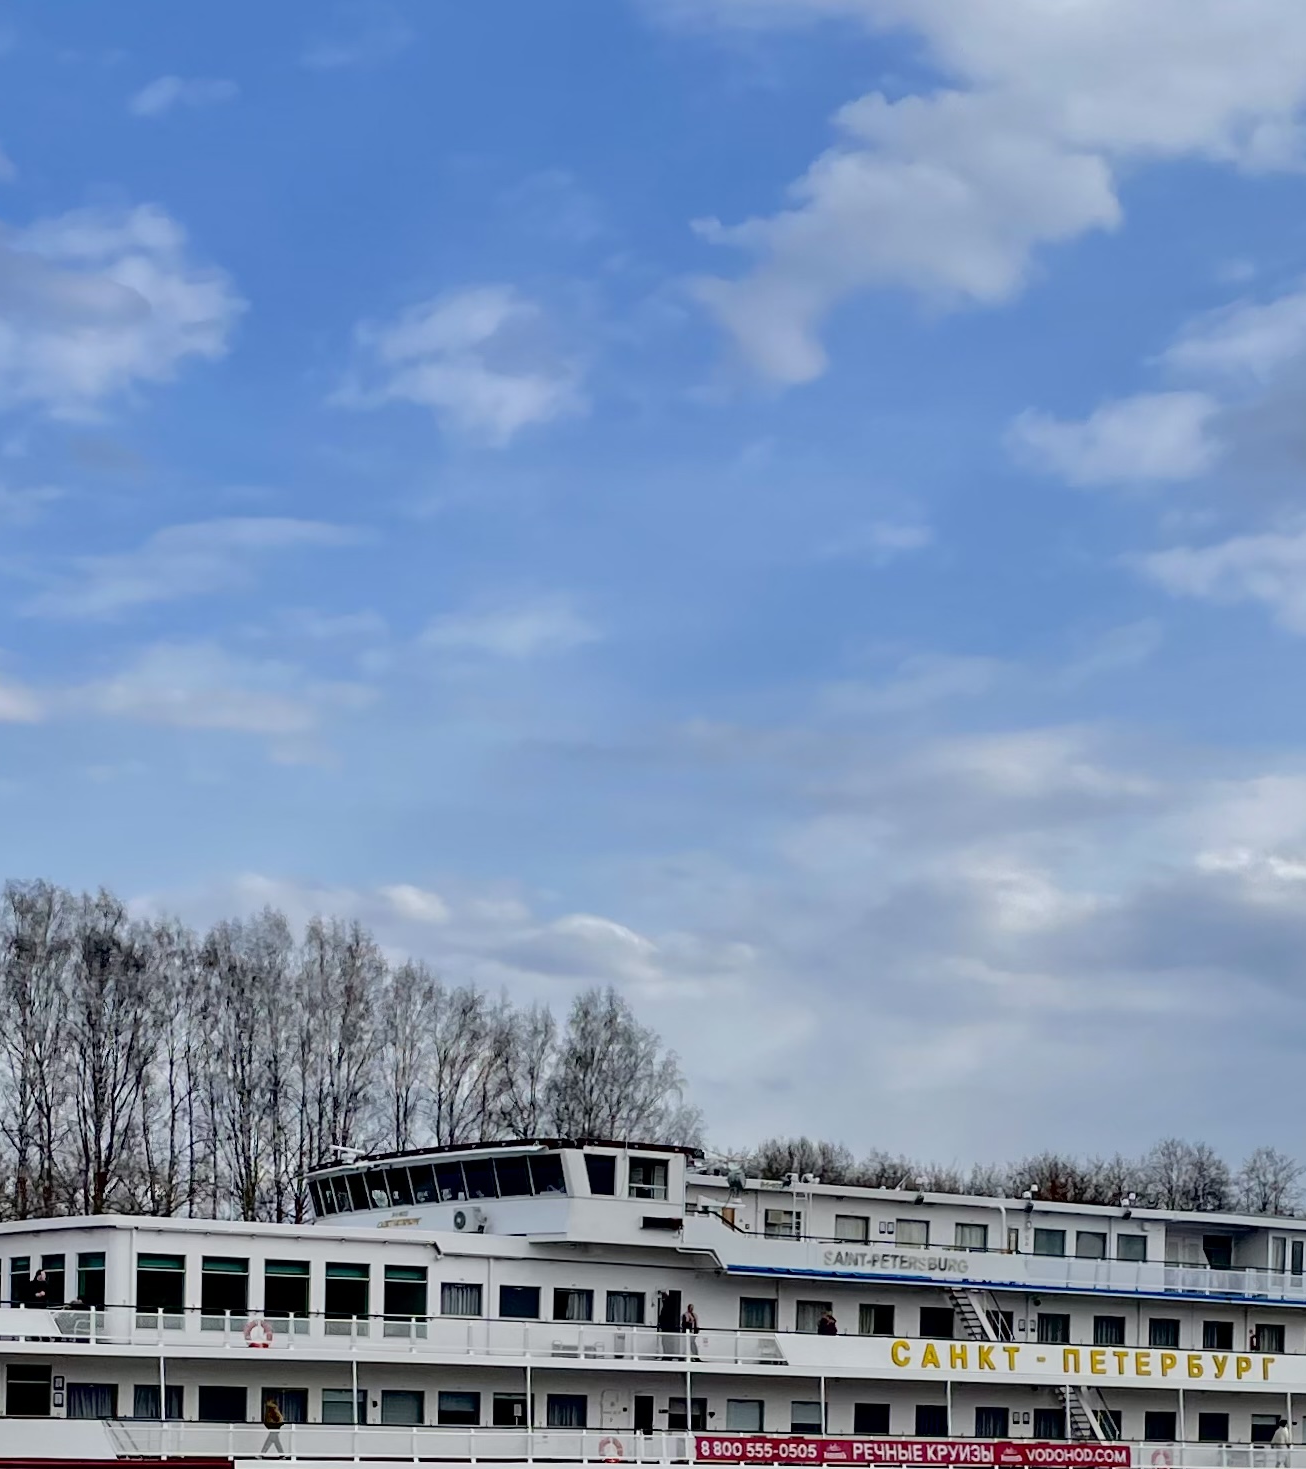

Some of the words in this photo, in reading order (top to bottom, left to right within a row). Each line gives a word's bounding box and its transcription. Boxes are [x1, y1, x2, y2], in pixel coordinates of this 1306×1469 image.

[823, 1251, 969, 1273] SAINT-PETERSBURG
[700, 1440, 710, 1456] 8
[712, 1441, 743, 1457] 800
[746, 1443, 818, 1459] 555-0505
[852, 1443, 923, 1461] РЕЧНЫЕ
[926, 1445, 994, 1463] КРУИЗЫ
[1025, 1448, 1127, 1464] VODOHOD.COM
